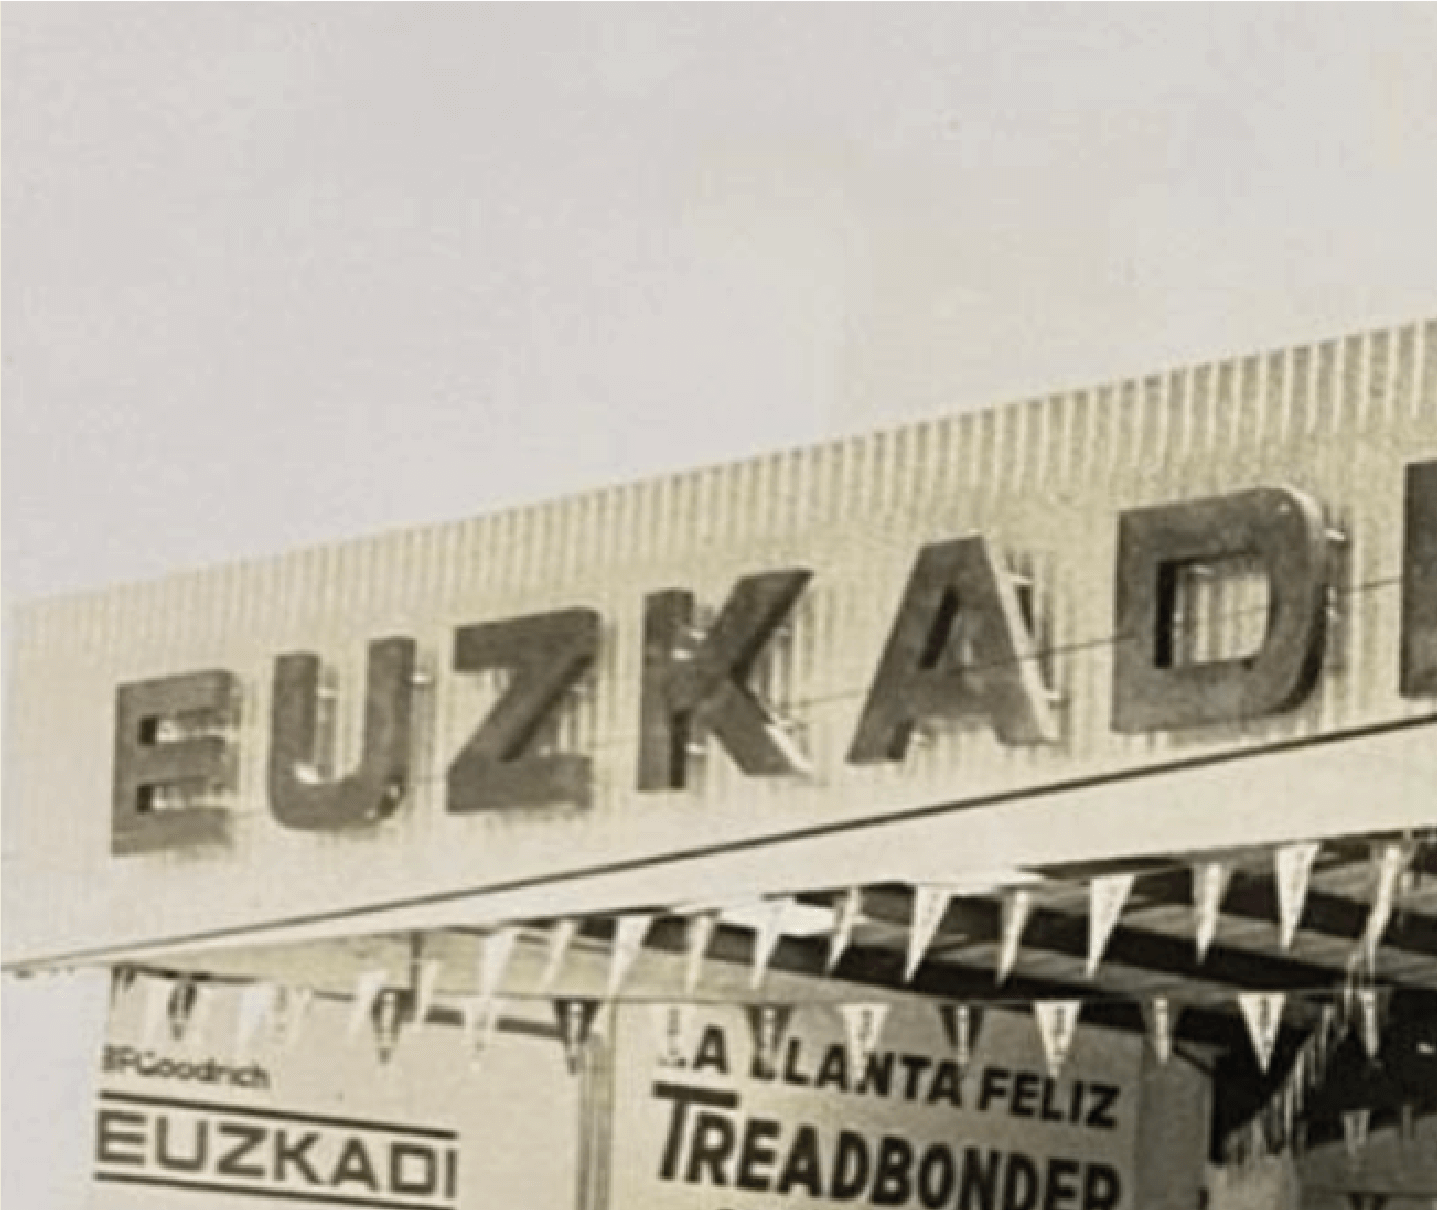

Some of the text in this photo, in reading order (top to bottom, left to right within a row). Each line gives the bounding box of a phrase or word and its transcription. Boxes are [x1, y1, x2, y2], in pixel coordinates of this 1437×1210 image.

[657, 1022, 729, 1075] A
[977, 1063, 1121, 1130] FELIZ
[96, 1107, 458, 1199] EUZKADI
